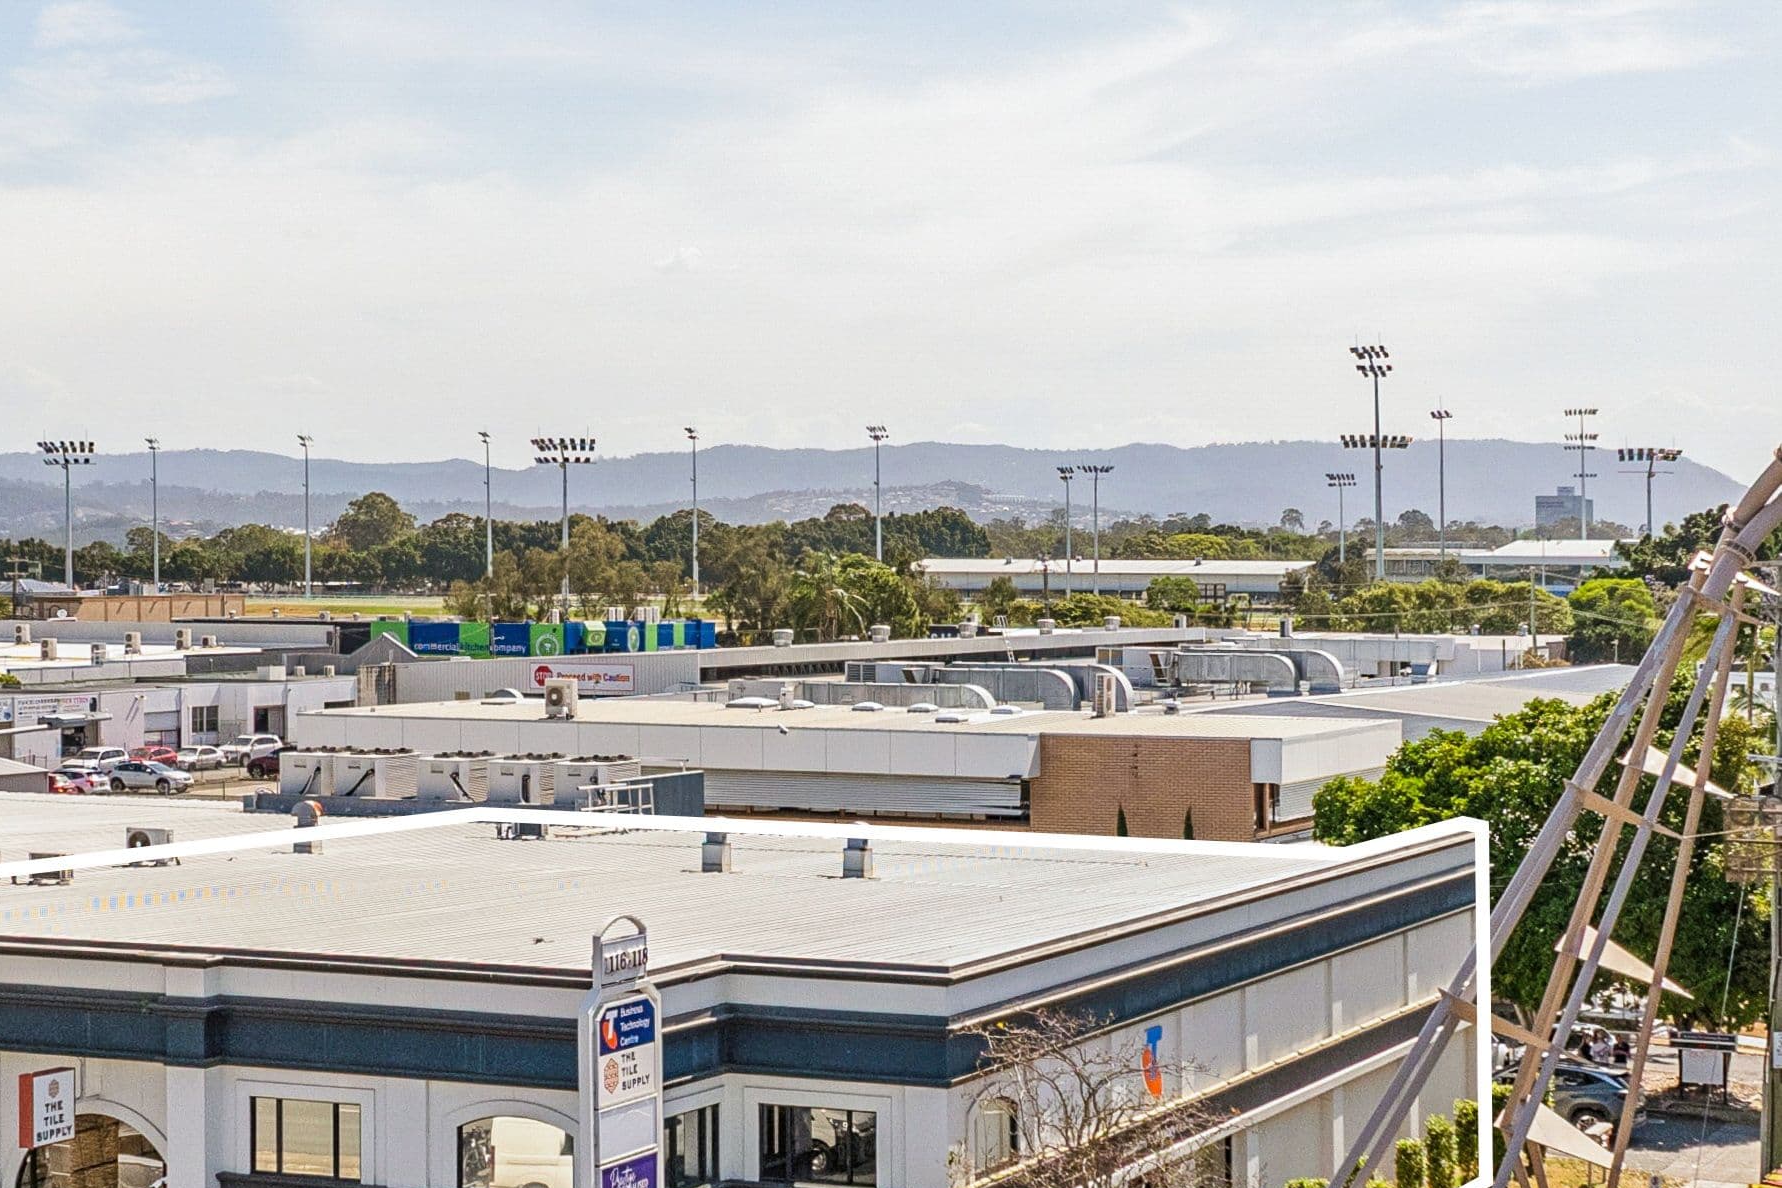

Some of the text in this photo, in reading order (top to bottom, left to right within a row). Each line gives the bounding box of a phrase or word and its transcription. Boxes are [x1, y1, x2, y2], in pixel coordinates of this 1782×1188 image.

[414, 642, 459, 651] commercial
[620, 1005, 644, 1018] Business
[620, 1017, 651, 1032] Technology
[620, 1034, 640, 1047] Centre
[620, 1051, 636, 1064] THE
[621, 1063, 638, 1077] TILE
[621, 1073, 651, 1091] SUPPLY
[44, 1100, 63, 1113] THE
[43, 1113, 65, 1127] TILE
[36, 1125, 73, 1142] SUPPLY
